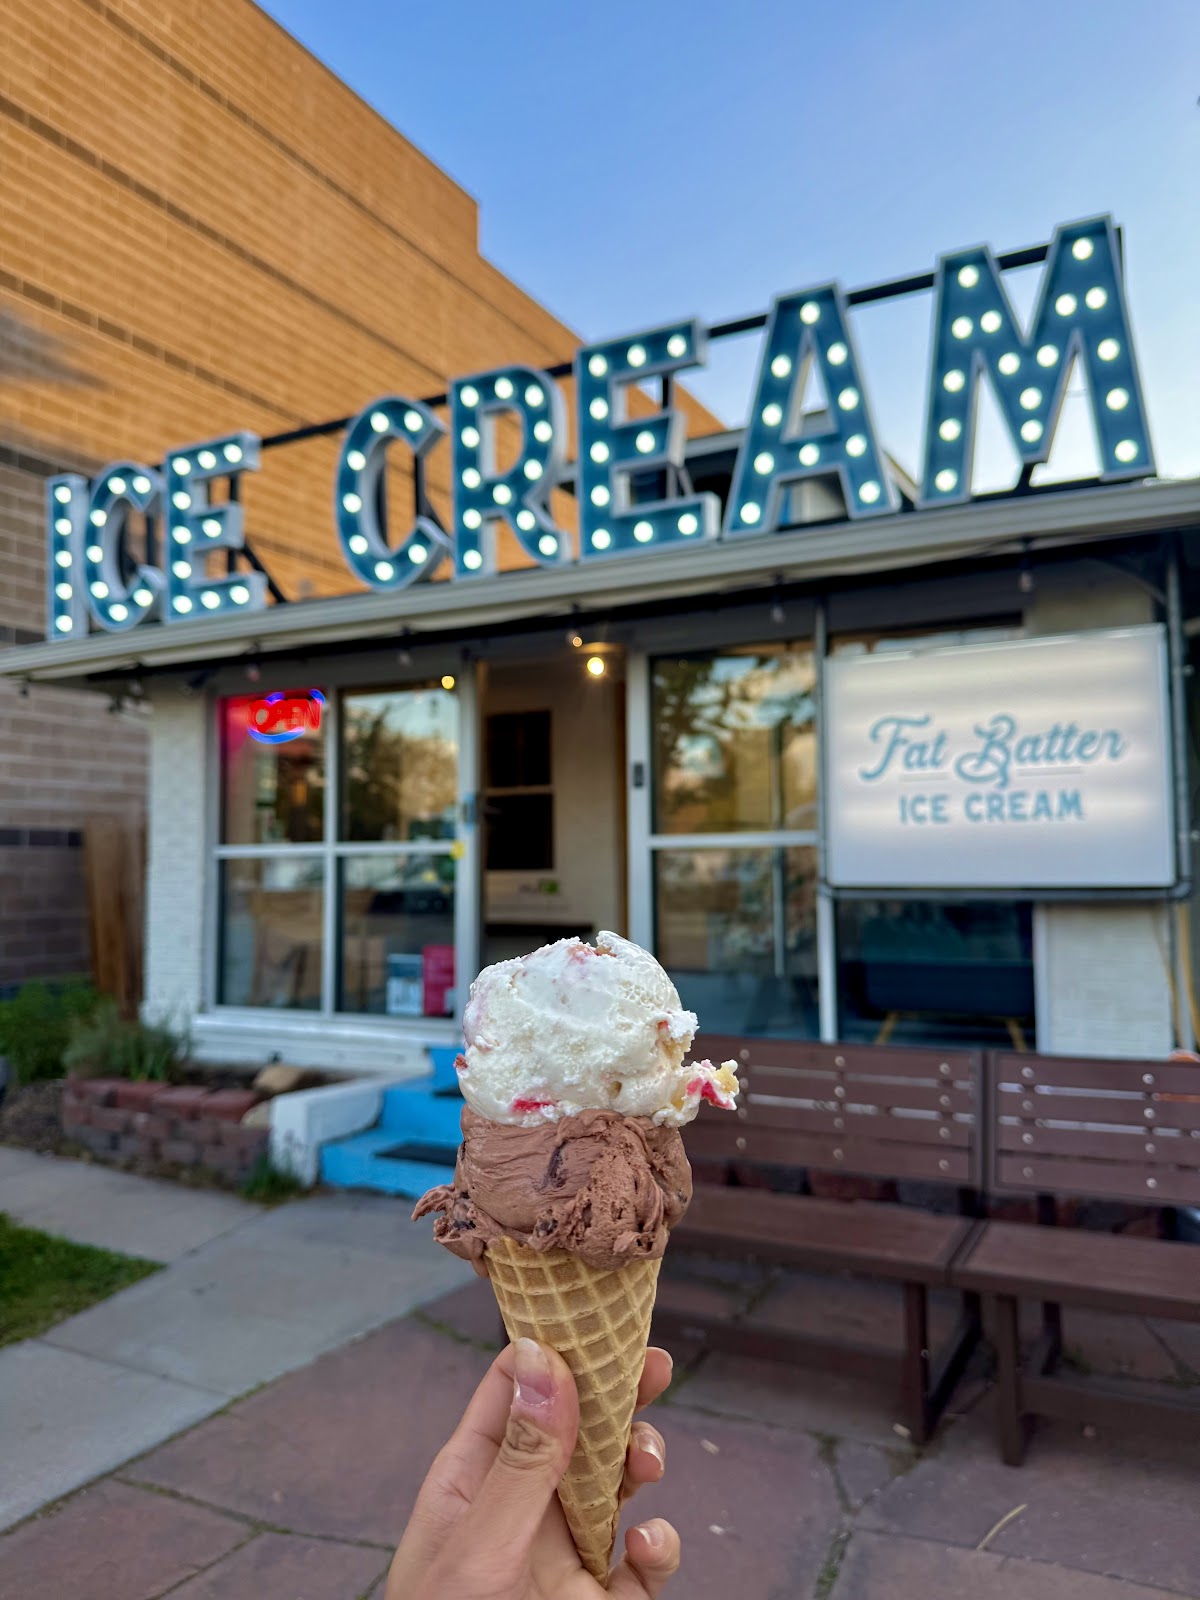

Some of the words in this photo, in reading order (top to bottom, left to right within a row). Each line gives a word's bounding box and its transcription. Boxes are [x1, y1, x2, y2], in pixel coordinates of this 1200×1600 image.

[47, 430, 267, 641] ICE
[336, 213, 1157, 592] CREAM
[248, 699, 323, 732] OPEN
[859, 714, 948, 781] Fat
[954, 713, 1124, 788] Batter
[899, 794, 950, 824] ICE
[963, 788, 1084, 823] CREAM
